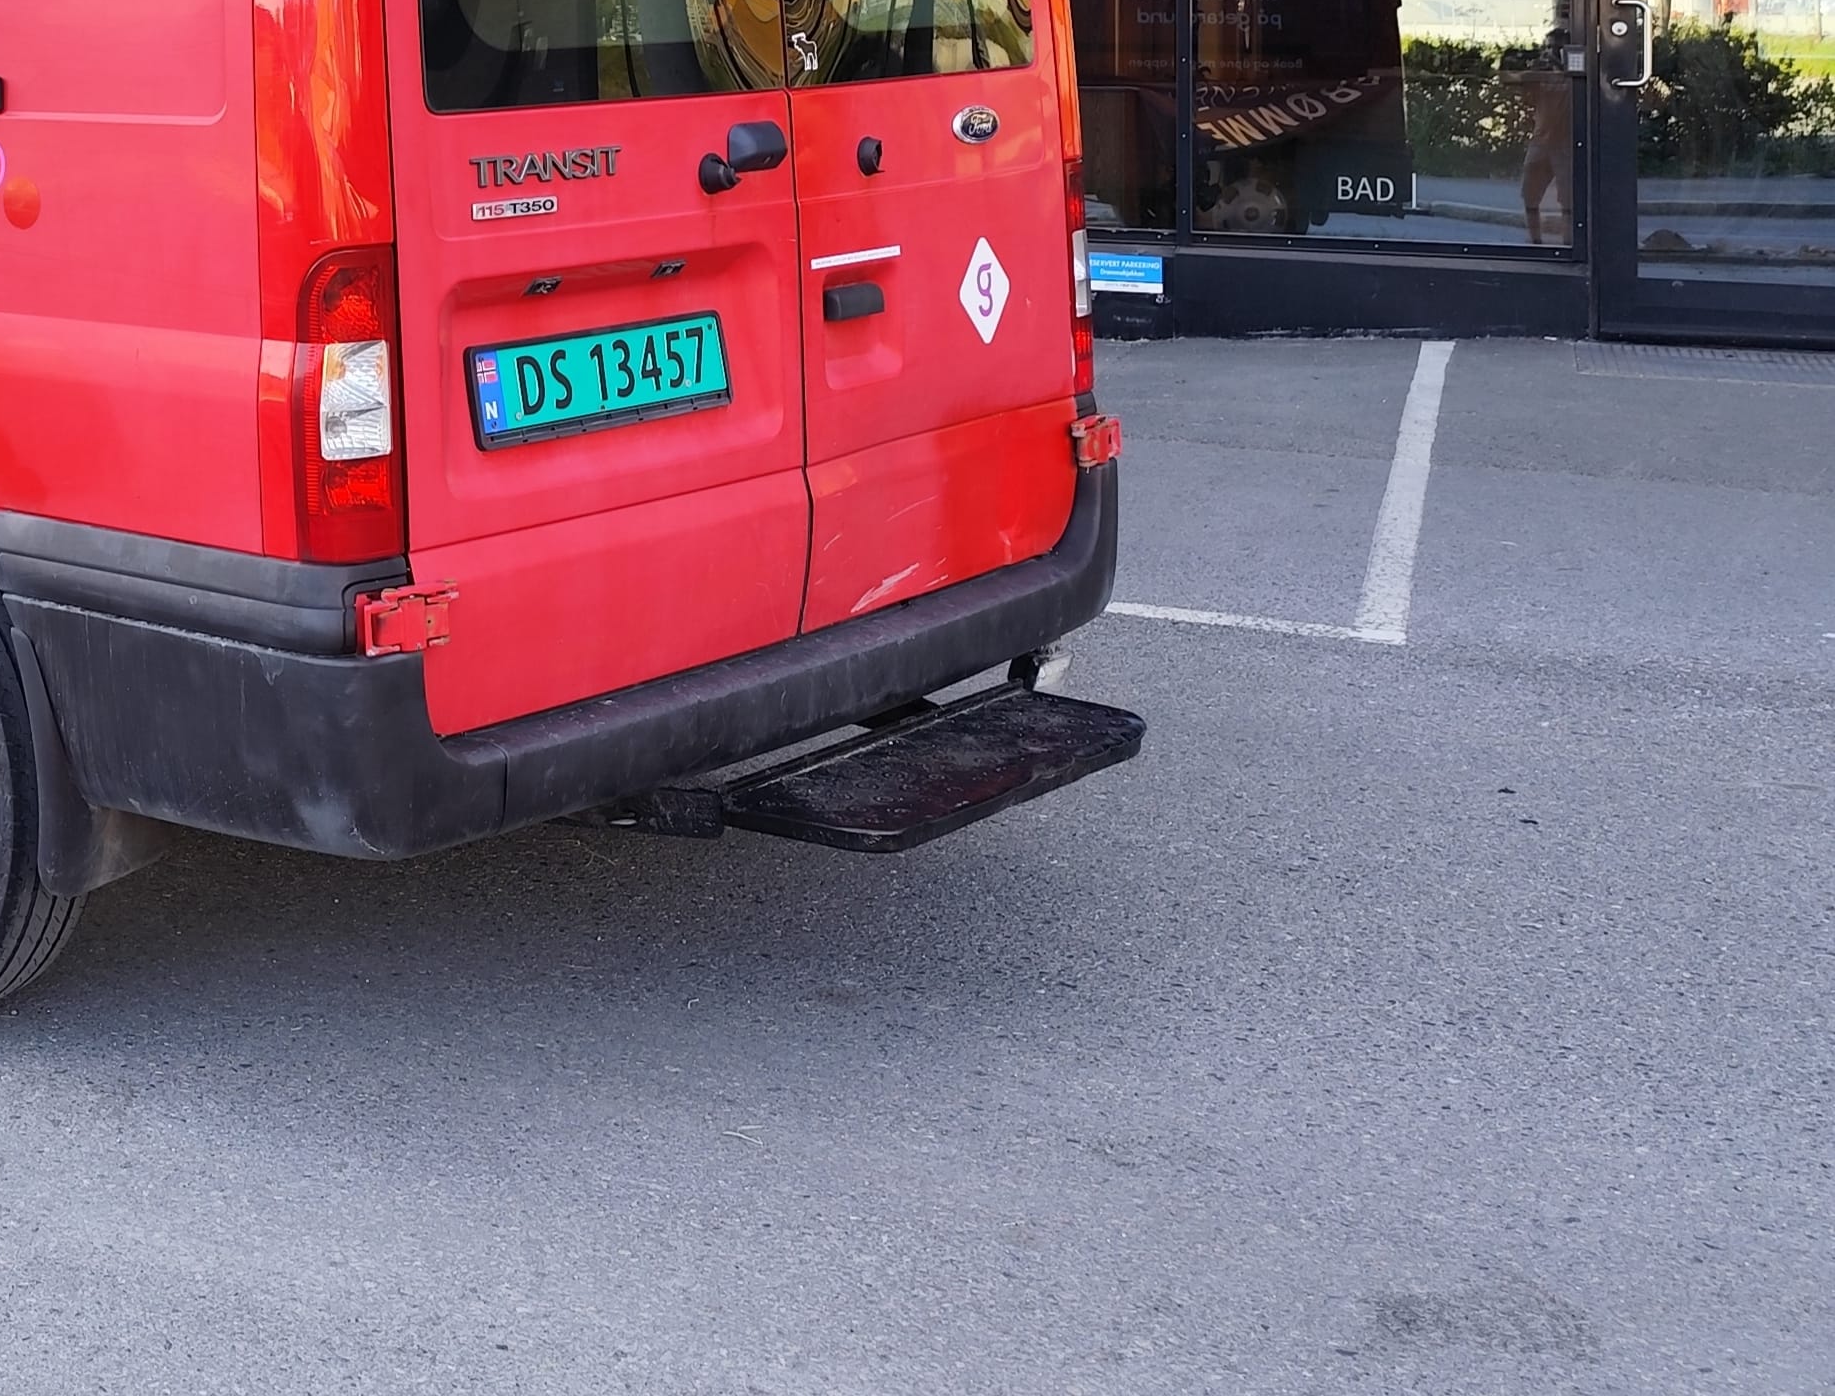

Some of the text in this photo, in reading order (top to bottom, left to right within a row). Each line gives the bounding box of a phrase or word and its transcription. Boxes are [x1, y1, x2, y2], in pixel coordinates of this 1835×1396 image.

[968, 113, 994, 135] Ford
[469, 145, 621, 188] TRANSIT
[1337, 175, 1394, 202] BAD
[509, 198, 555, 214] T350
[516, 327, 704, 415] DS 13457
[485, 401, 498, 420] N
